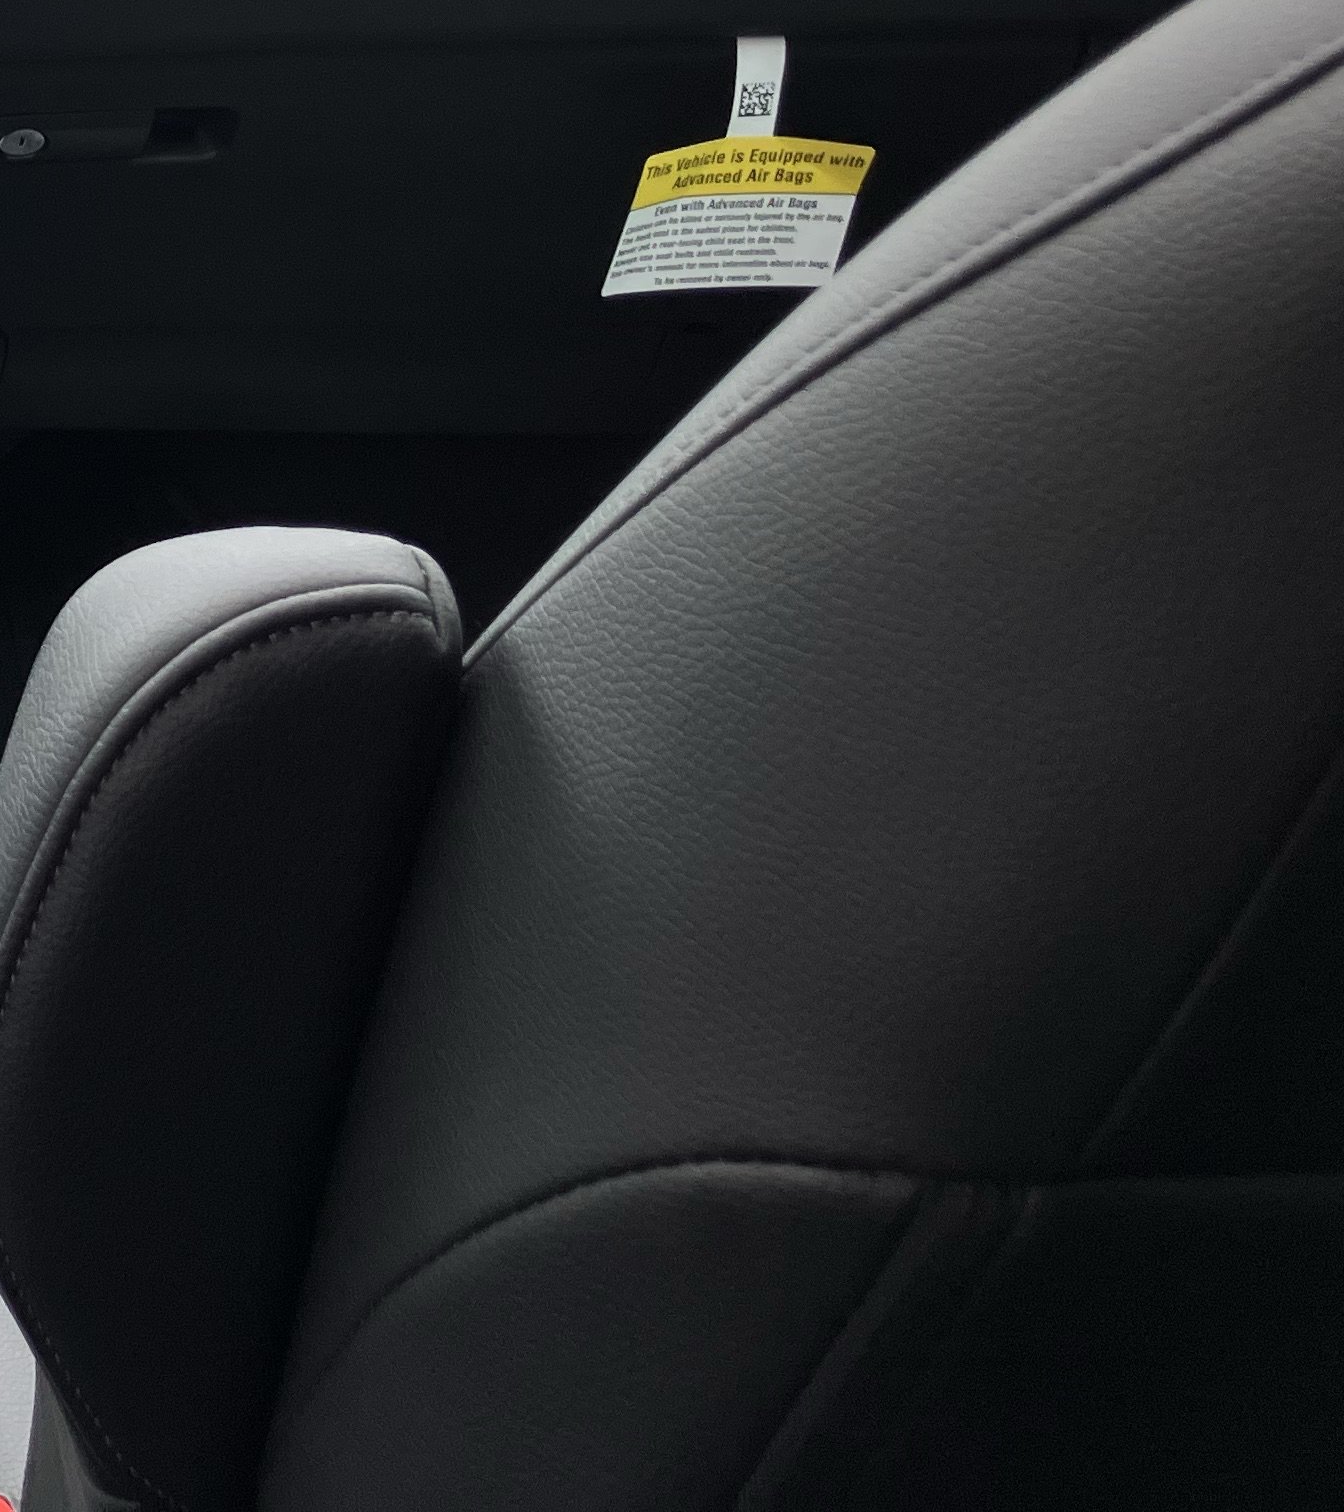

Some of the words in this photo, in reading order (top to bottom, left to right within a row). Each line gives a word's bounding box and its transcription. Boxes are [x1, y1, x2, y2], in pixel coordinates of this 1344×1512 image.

[647, 163, 672, 180] This
[676, 150, 725, 171] Vehicle
[730, 149, 743, 163] is
[749, 148, 825, 168] Equipped
[830, 152, 866, 168] with
[672, 168, 741, 189] Advanced
[746, 168, 769, 182] Air
[774, 168, 814, 185] Bags
